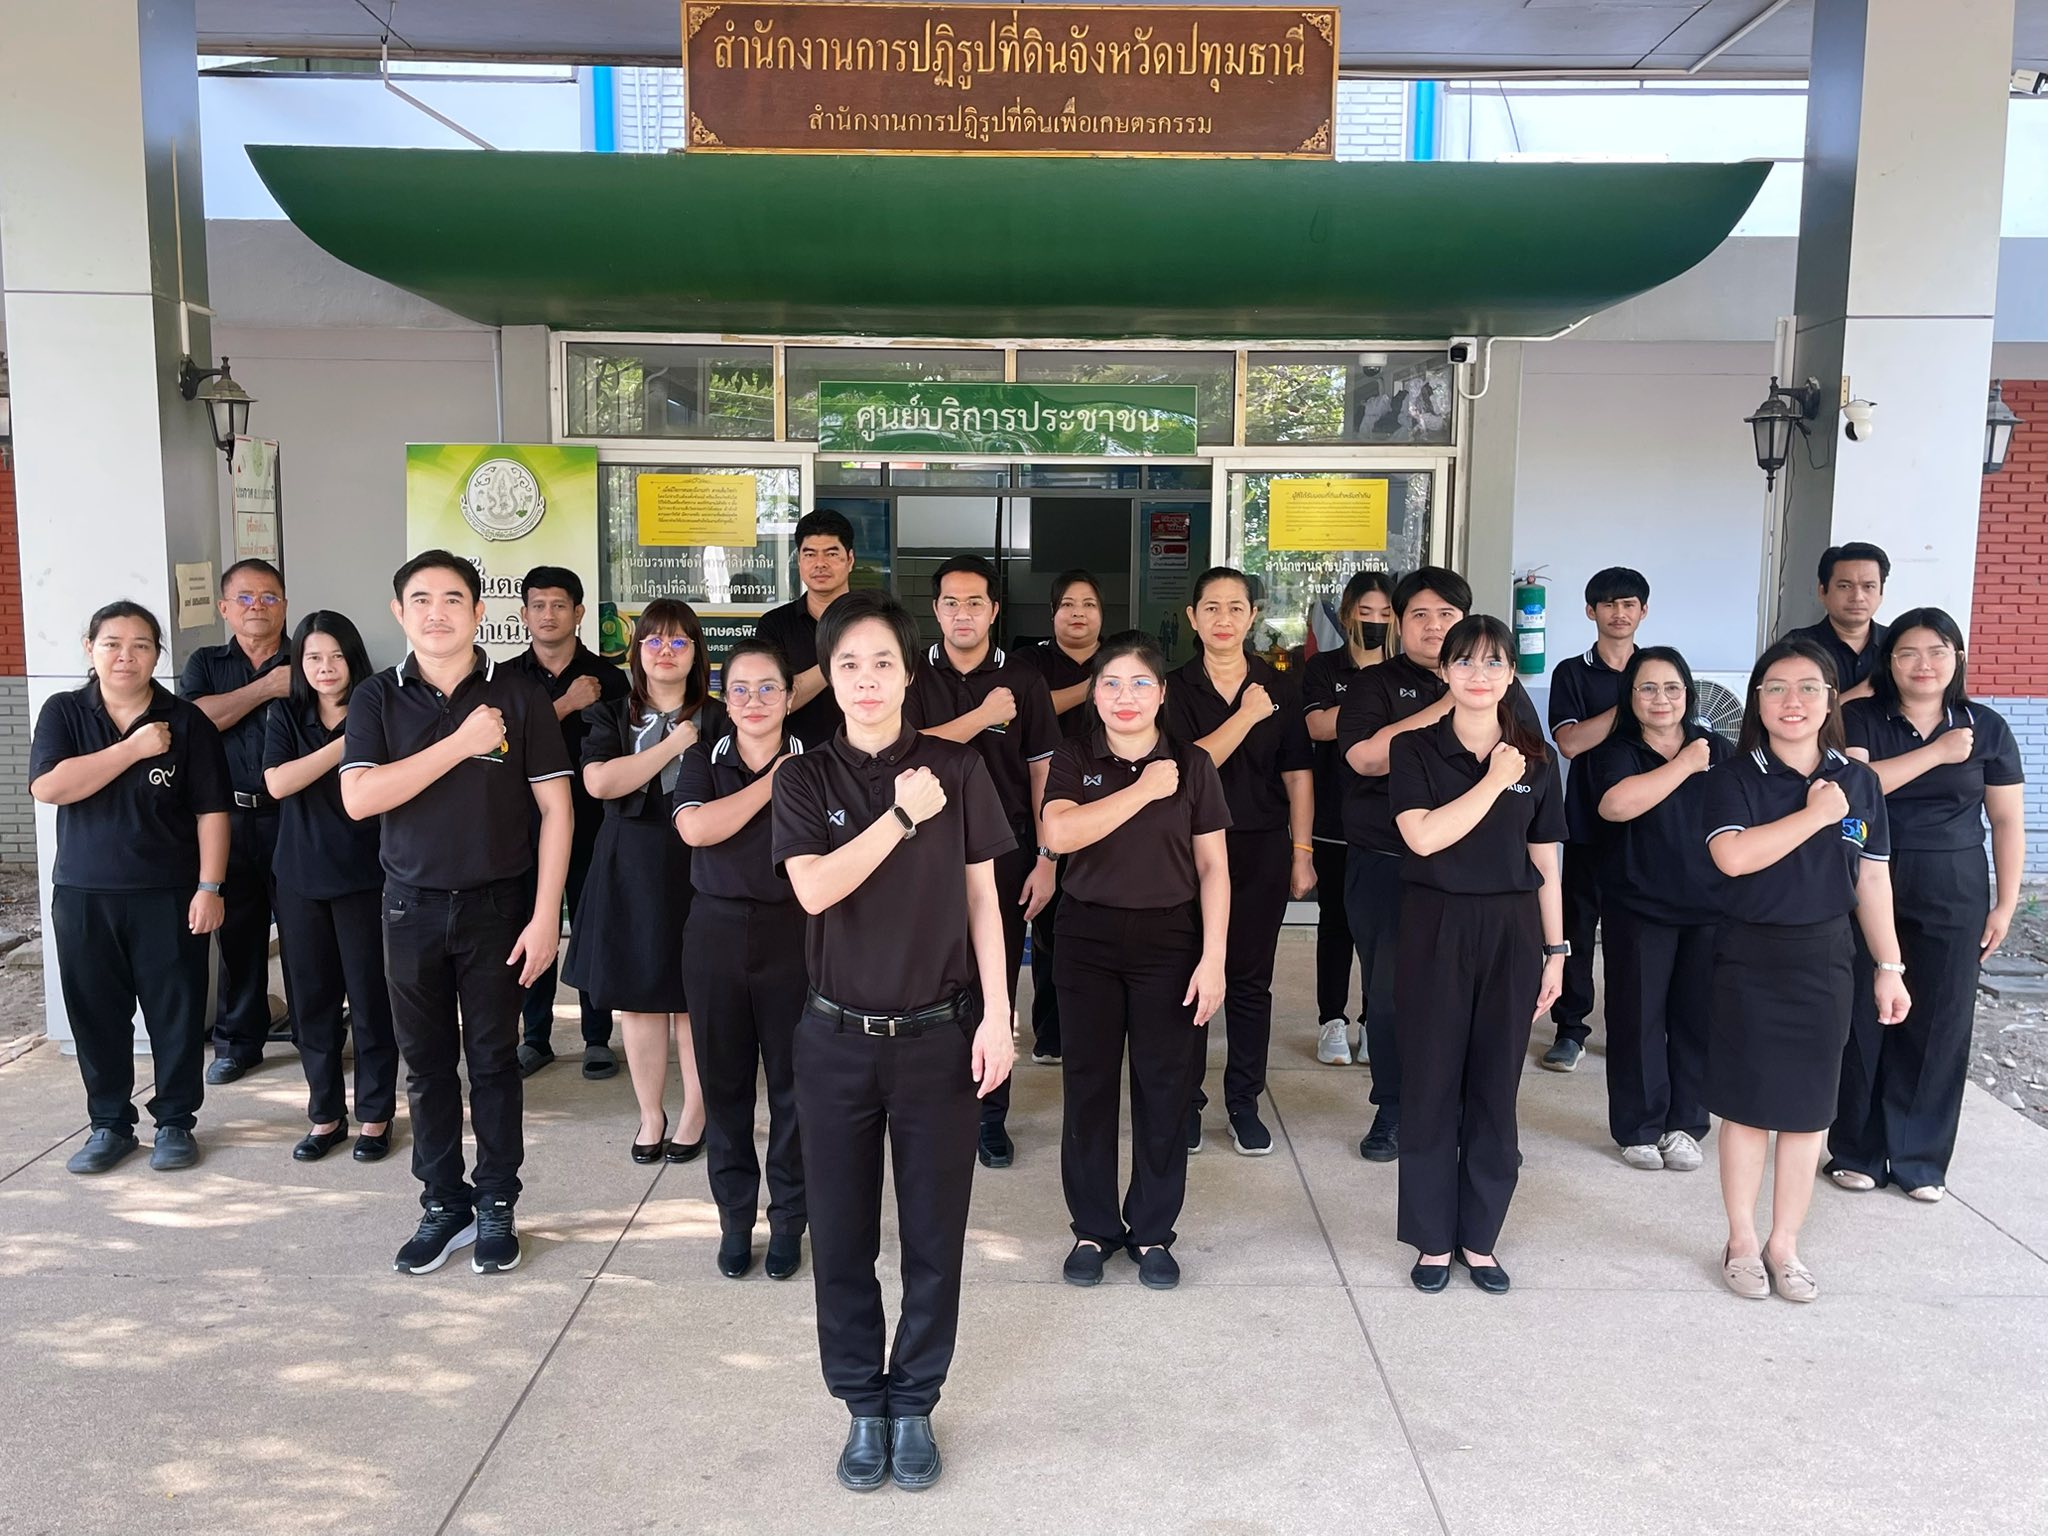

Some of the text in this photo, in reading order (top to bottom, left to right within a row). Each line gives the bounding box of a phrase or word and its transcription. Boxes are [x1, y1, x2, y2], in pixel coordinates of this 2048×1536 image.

[713, 10, 1306, 93] สำนักงานการปฏิรูปที่ดินจังหวัดปทุมธานี
[807, 97, 1213, 142] สำนักงานการปฏิรูปที่ดินเพื่อเกษตรกรรม
[856, 393, 1161, 442] ศูนย์บริการประชาชน
[1307, 579, 1346, 595] จังหวัด
